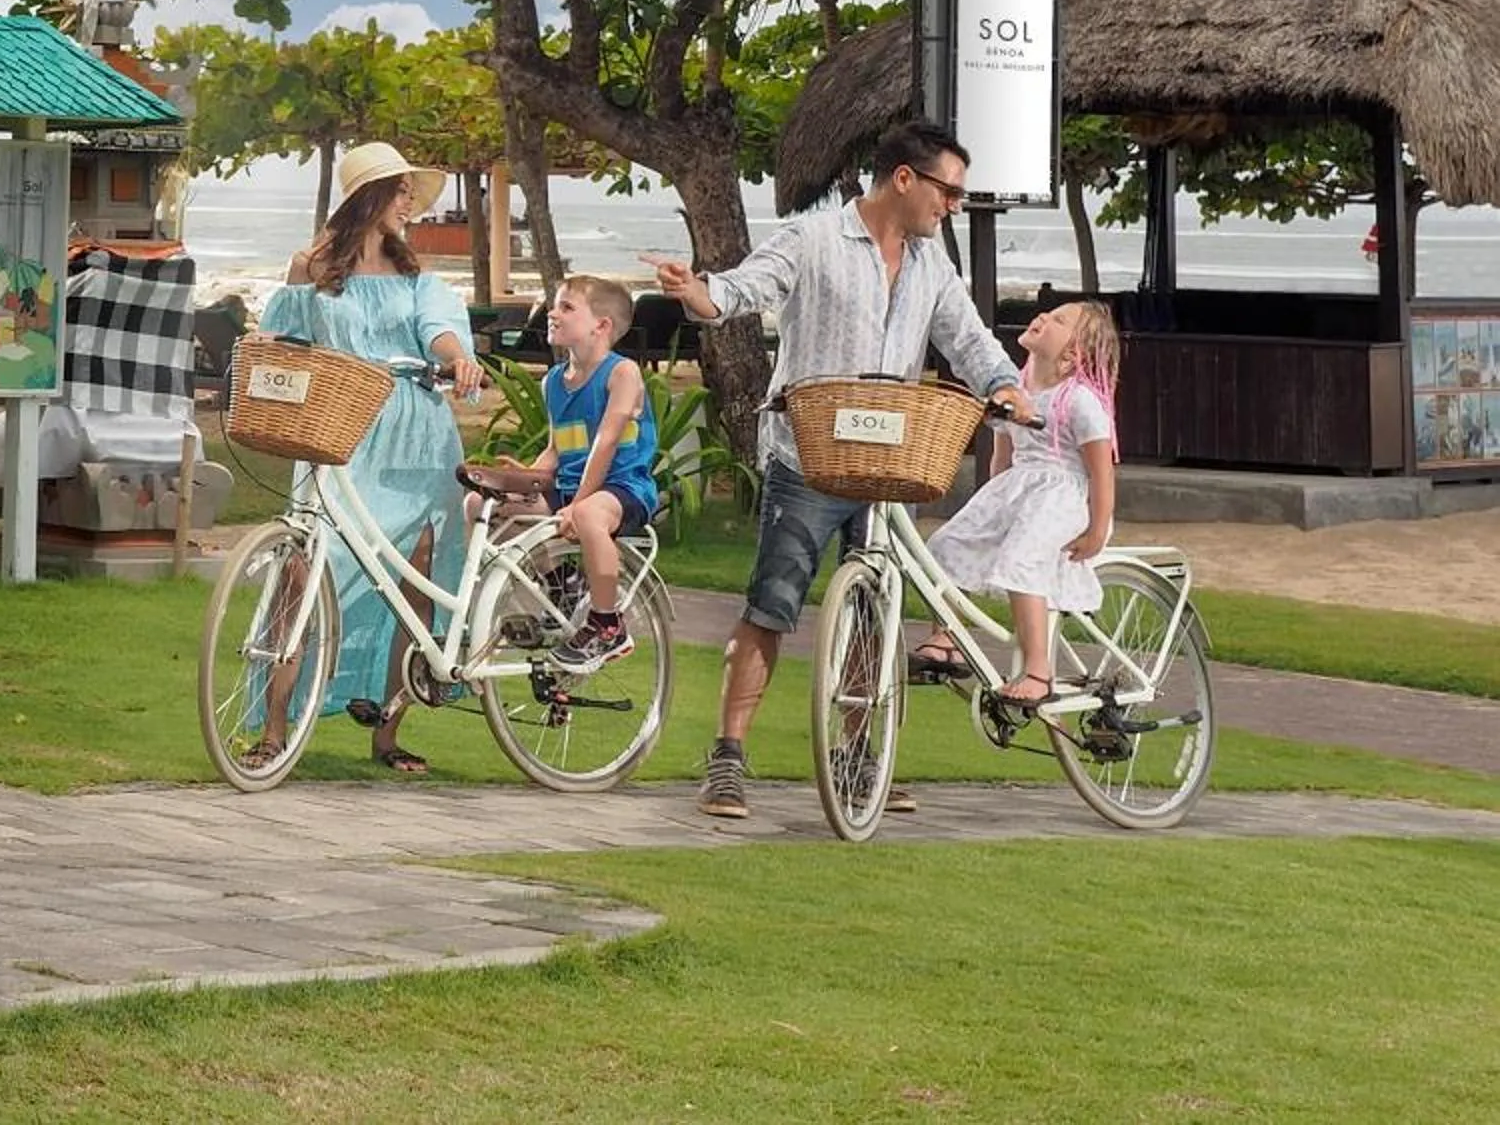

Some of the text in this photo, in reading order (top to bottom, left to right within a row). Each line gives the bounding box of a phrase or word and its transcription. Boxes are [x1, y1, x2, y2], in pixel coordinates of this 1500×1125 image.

[979, 18, 1033, 43] SOL
[263, 372, 293, 388] SOL
[851, 414, 887, 430] SOL
